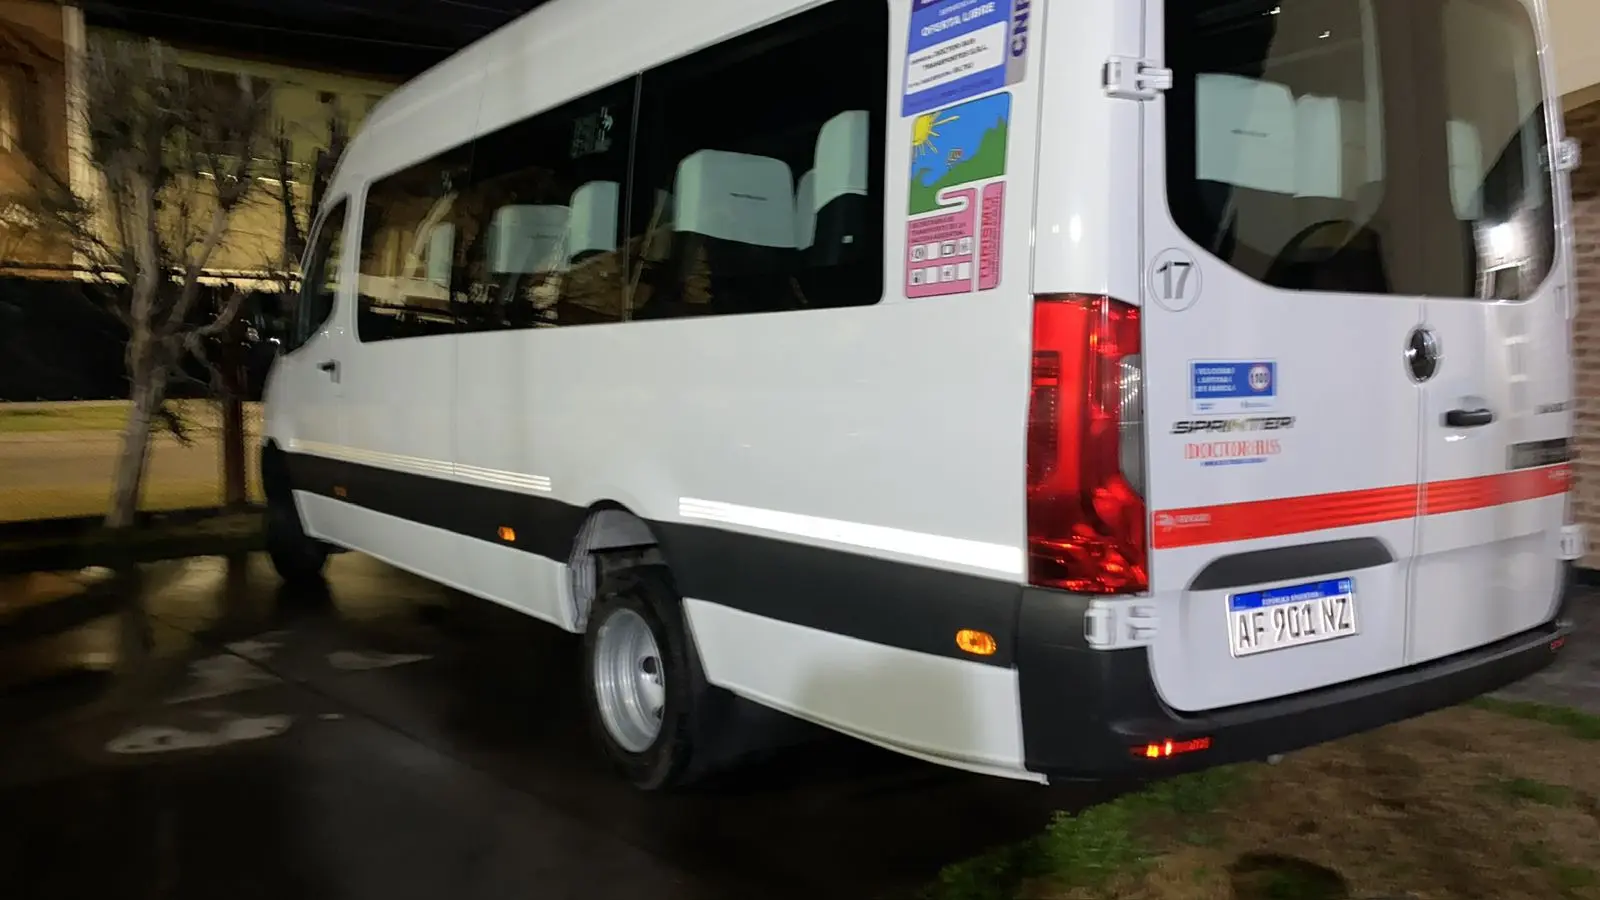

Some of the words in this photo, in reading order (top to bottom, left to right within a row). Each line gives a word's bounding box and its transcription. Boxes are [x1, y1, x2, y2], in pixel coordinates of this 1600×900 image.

[1156, 260, 1194, 299] 17
[1170, 416, 1296, 434] SPRINTER
[1238, 611, 1265, 649] AF
[1272, 602, 1317, 642] 901
[1320, 597, 1351, 634] NZ
